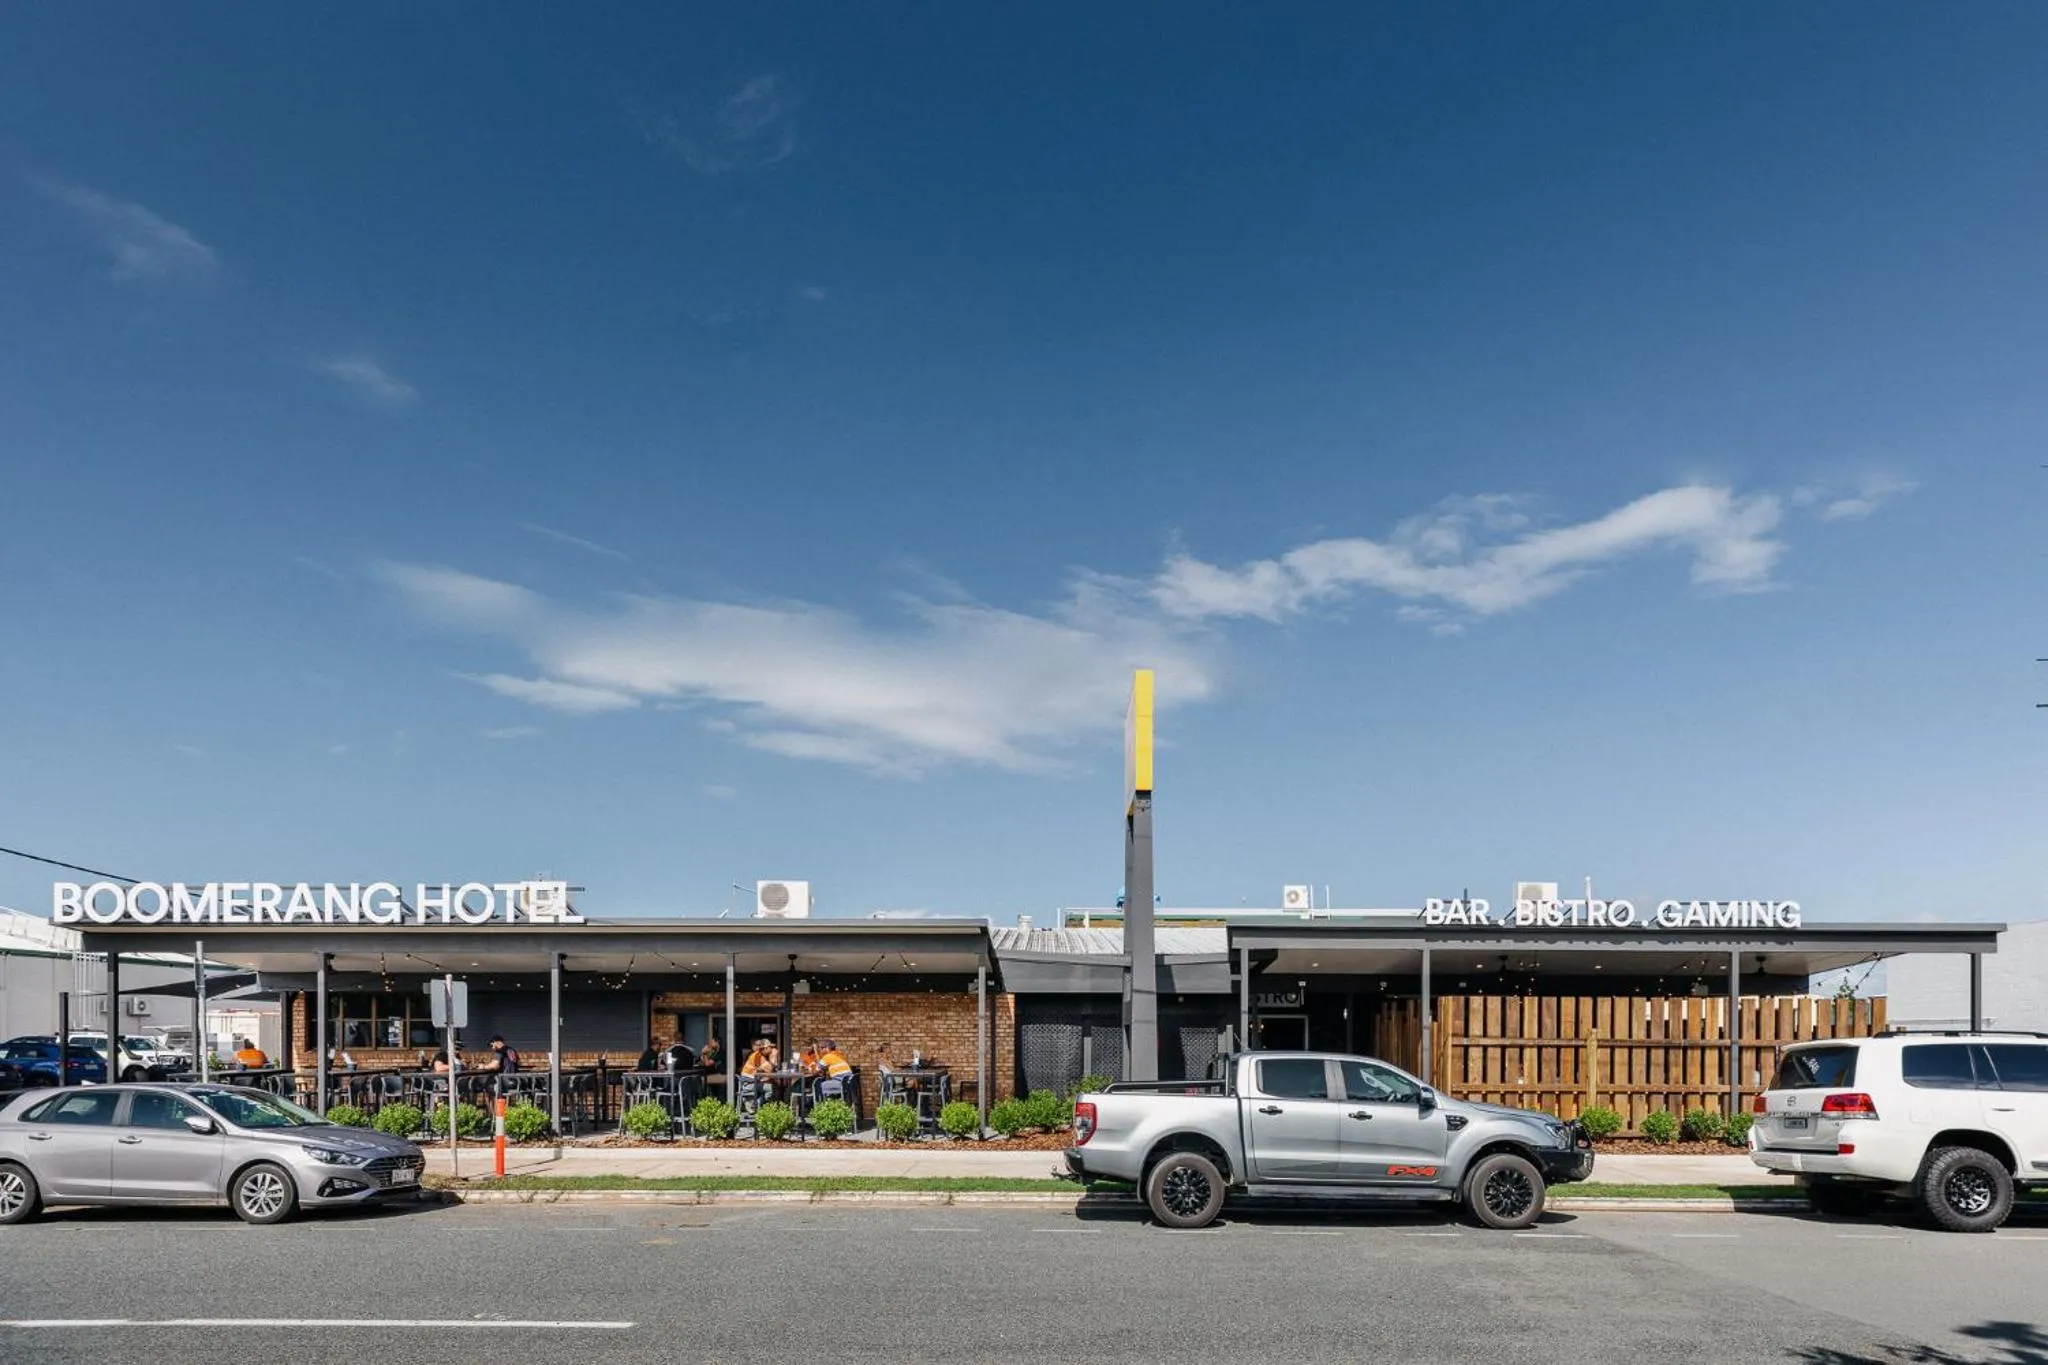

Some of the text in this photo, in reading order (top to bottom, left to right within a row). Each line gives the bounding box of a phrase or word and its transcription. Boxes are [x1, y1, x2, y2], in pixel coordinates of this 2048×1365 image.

[53, 882, 585, 924] BOOMERANG HOTEL
[1656, 900, 1801, 928] GAMING
